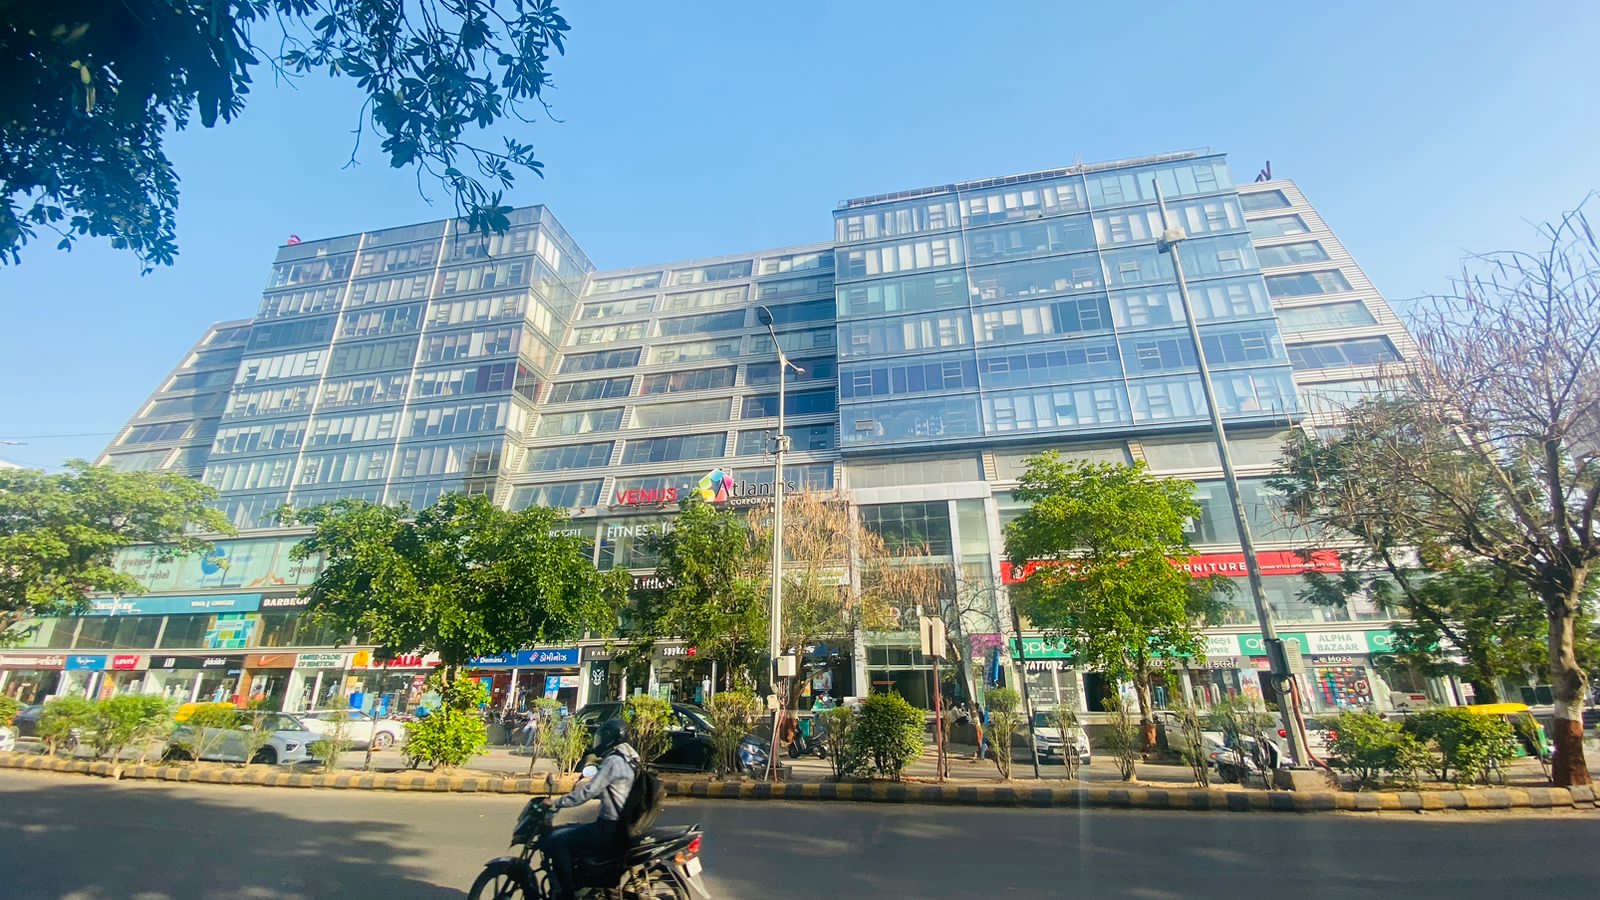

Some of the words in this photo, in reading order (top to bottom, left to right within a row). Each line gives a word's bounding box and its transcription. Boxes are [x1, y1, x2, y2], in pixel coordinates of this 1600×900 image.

[616, 487, 679, 505] VENUS
[1319, 634, 1353, 642] ALPHA
[1317, 643, 1360, 651] BAZAAR
